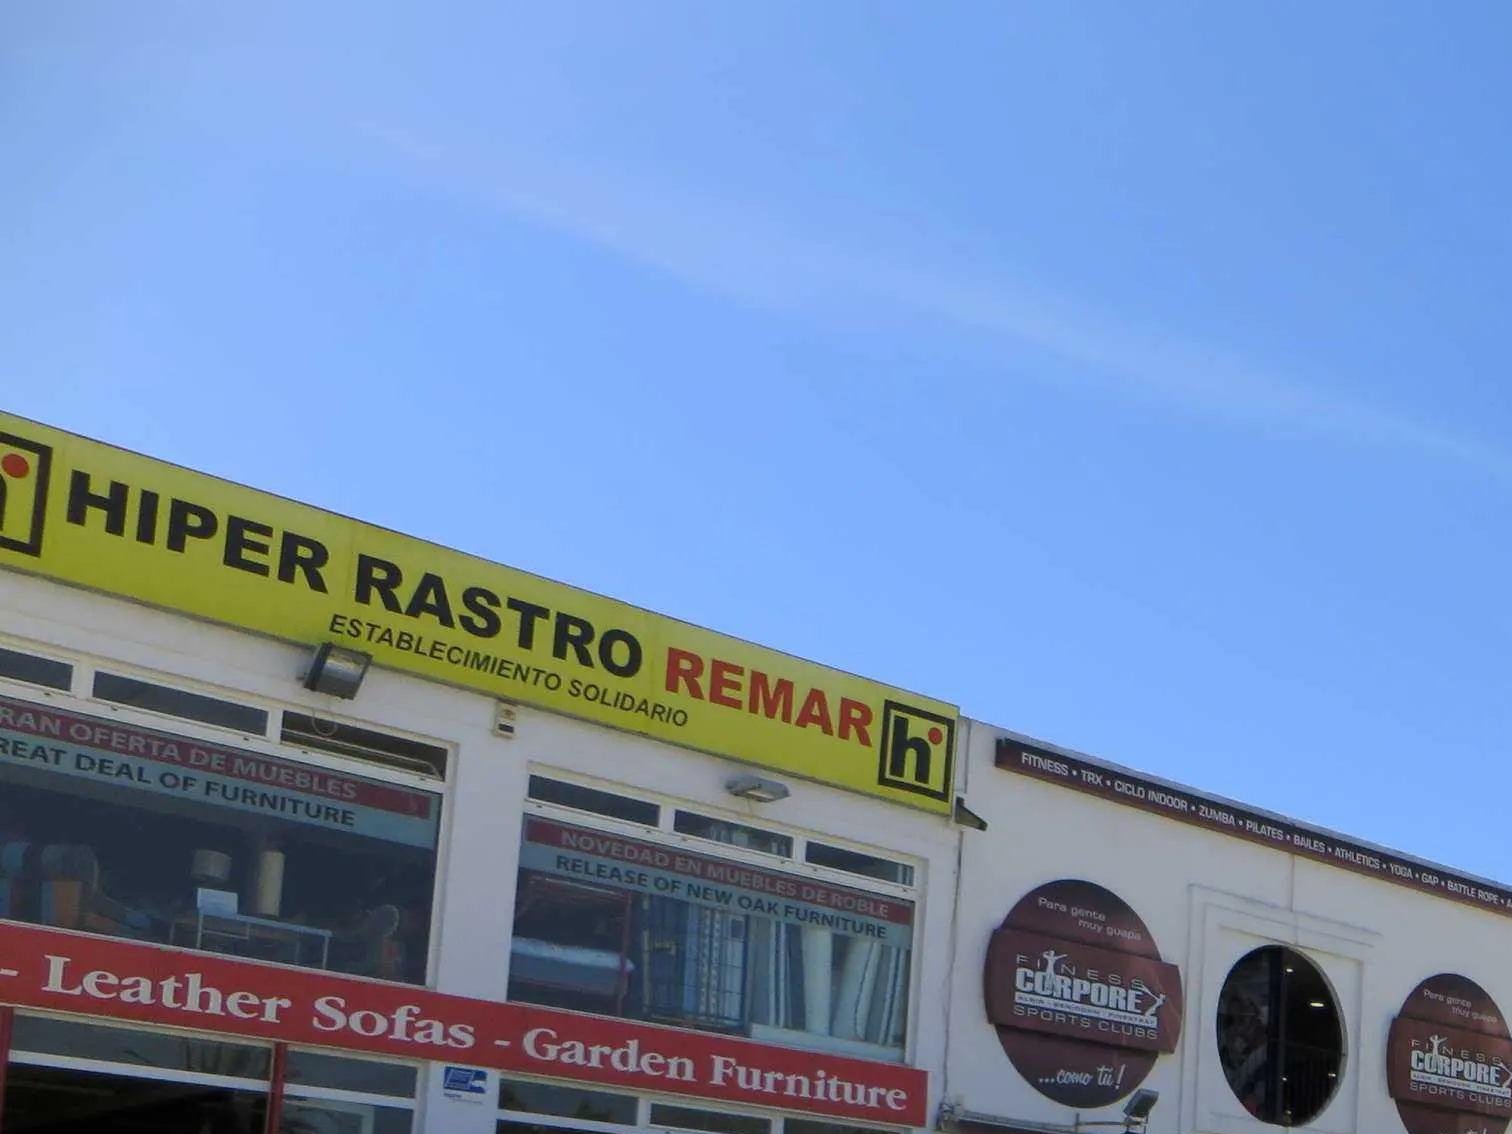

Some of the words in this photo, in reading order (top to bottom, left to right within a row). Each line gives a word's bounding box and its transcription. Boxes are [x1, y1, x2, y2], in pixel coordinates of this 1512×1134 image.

[66, 469, 330, 593] HIPER
[354, 554, 642, 677] RASTRO
[665, 647, 873, 747] REMAR
[329, 613, 562, 691] ESTABLECIMIENTO
[568, 678, 687, 727] SOLIDARIO
[69, 723, 179, 761] OFERTA
[189, 748, 226, 771] DE
[233, 757, 357, 800] MUEBLES
[75, 753, 150, 783] DEAL
[160, 772, 197, 792] OF
[205, 780, 355, 827] FURNITURE
[1021, 752, 1068, 776] FITNESS
[1081, 769, 1103, 787] TRX
[1114, 780, 1145, 799] CICLO
[1148, 790, 1188, 812] INDOOR
[1199, 805, 1235, 826] ZUMBA
[1246, 819, 1283, 841] PILATES
[1294, 834, 1325, 853] BAILES
[1335, 847, 1380, 869] ATHLETICS
[1390, 863, 1413, 879] YOGA
[1421, 872, 1439, 887] GAP
[1447, 880, 1475, 898] BATTLE
[1478, 889, 1498, 904] ROPE
[556, 855, 648, 887] RELEASE
[654, 874, 681, 895] OF
[686, 882, 732, 908] NEW
[738, 893, 780, 917] OAK
[783, 902, 886, 939] FURNITURE
[561, 830, 671, 867] NOVEDAD
[674, 854, 699, 874] EN
[706, 863, 797, 896] MUEBLES
[802, 885, 829, 905] DE
[830, 889, 889, 918] ROBLE
[1014, 1005, 1091, 1028] SPORTS
[1099, 1022, 1158, 1039] CLUBS
[1015, 967, 1146, 1013] CORPORE
[42, 955, 291, 1024] Leather
[313, 996, 475, 1048] Sofas
[523, 1028, 697, 1082] Garden
[710, 1055, 907, 1111] Furniture
[1411, 1050, 1500, 1086] CORPORE
[1410, 1082, 1464, 1100] SPORTS
